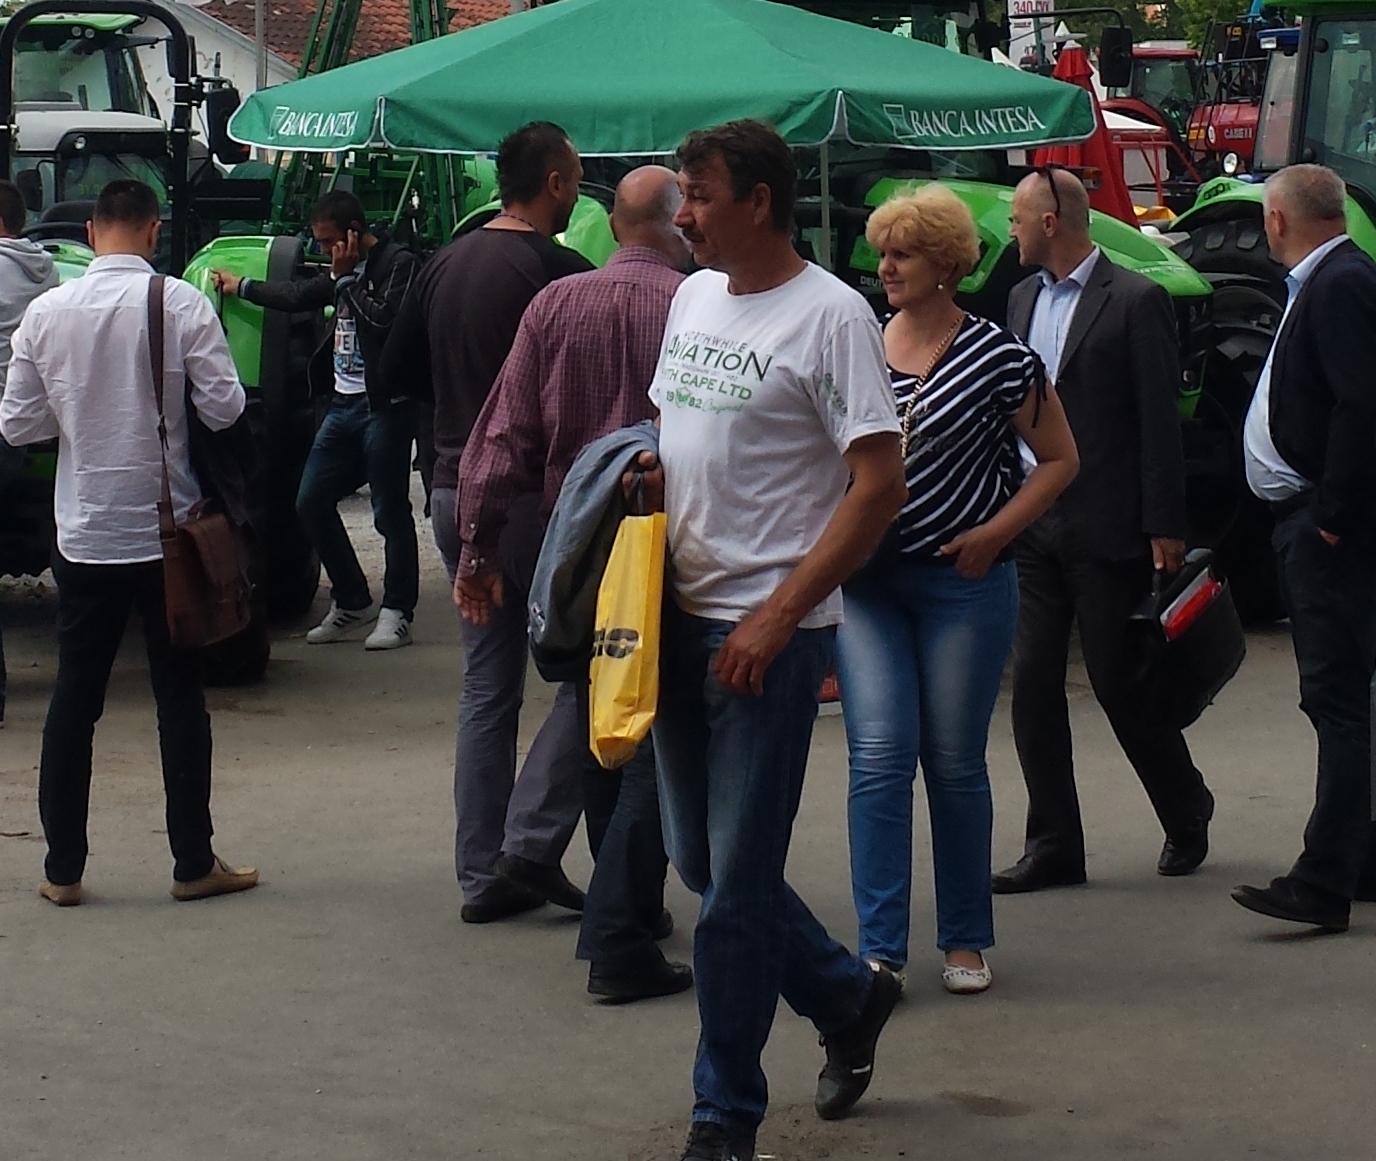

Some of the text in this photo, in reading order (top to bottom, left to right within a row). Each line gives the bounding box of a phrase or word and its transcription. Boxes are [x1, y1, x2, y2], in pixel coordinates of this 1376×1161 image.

[909, 105, 1047, 138] BANCA INTESA
[860, 275, 883, 288] DEUT
[680, 372, 718, 391] CAPE
[719, 380, 753, 401] LTD
[688, 397, 702, 409] 82
